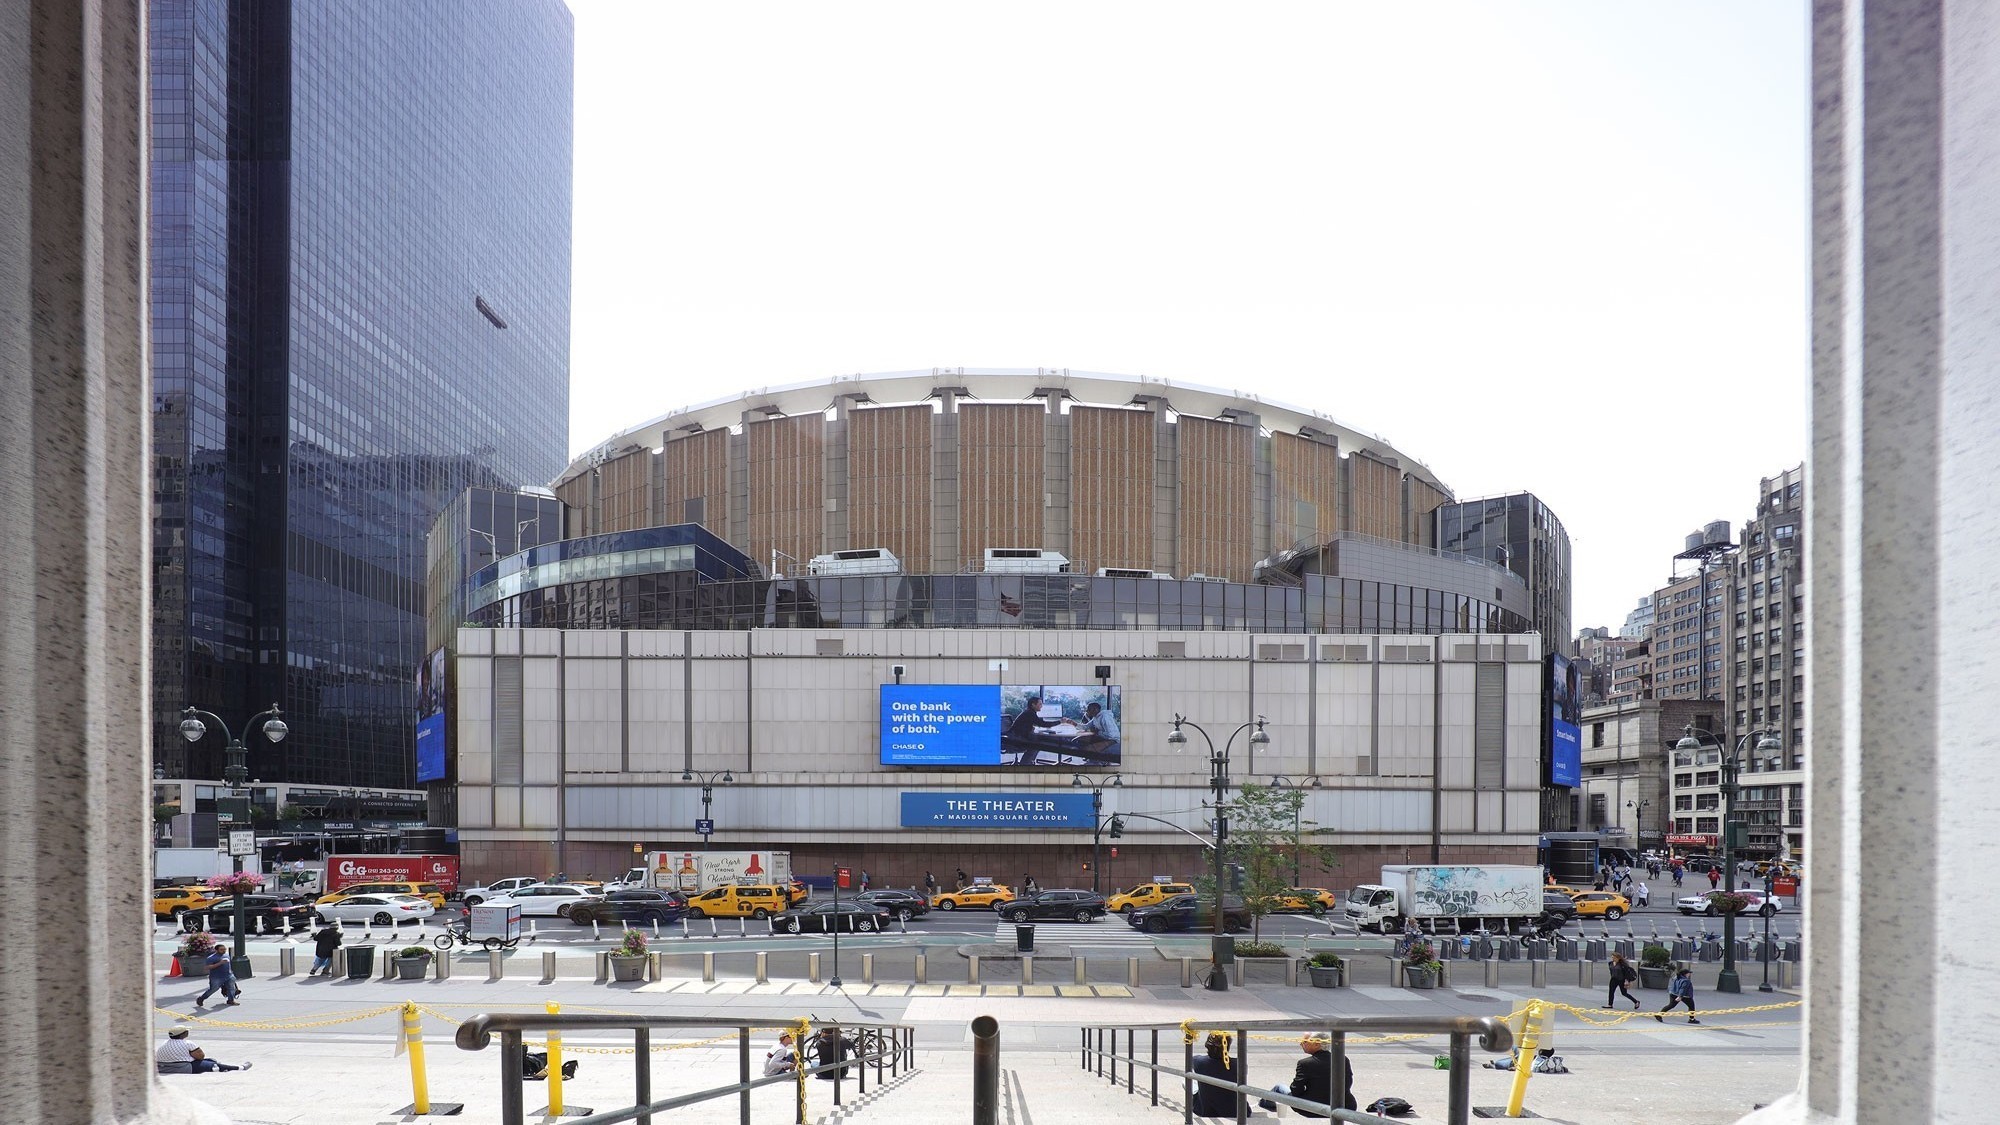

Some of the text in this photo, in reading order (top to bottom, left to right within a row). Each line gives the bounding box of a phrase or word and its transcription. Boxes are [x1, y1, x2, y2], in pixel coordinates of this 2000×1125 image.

[892, 701, 951, 711] One bank
[892, 712, 986, 724] with the power
[892, 724, 940, 734] of both.
[946, 800, 1055, 811] THE THEATER
[704, 858, 741, 870] New York
